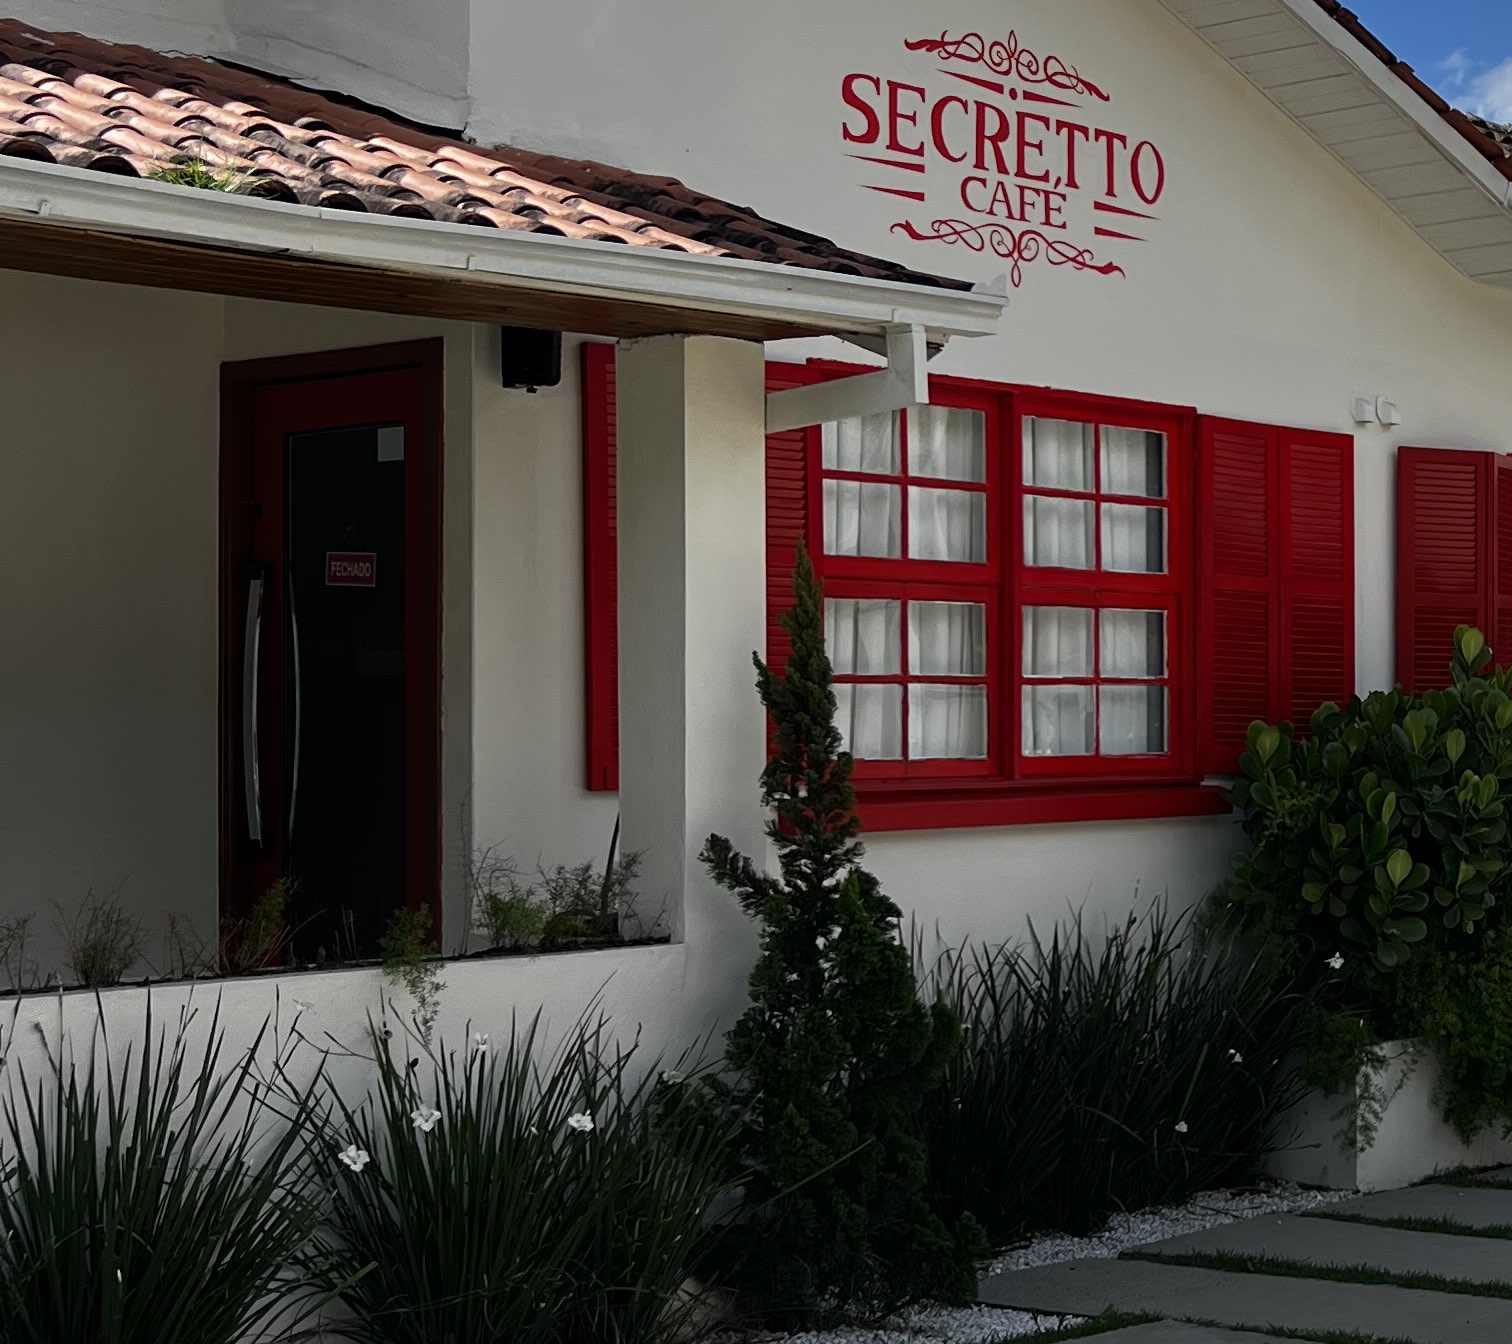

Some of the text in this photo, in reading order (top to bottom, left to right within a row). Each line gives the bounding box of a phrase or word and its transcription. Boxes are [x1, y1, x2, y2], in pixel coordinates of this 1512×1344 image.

[841, 73, 1165, 205] SECRETTO
[960, 176, 1067, 229] CAFÉ
[331, 561, 371, 576] FECHADO
